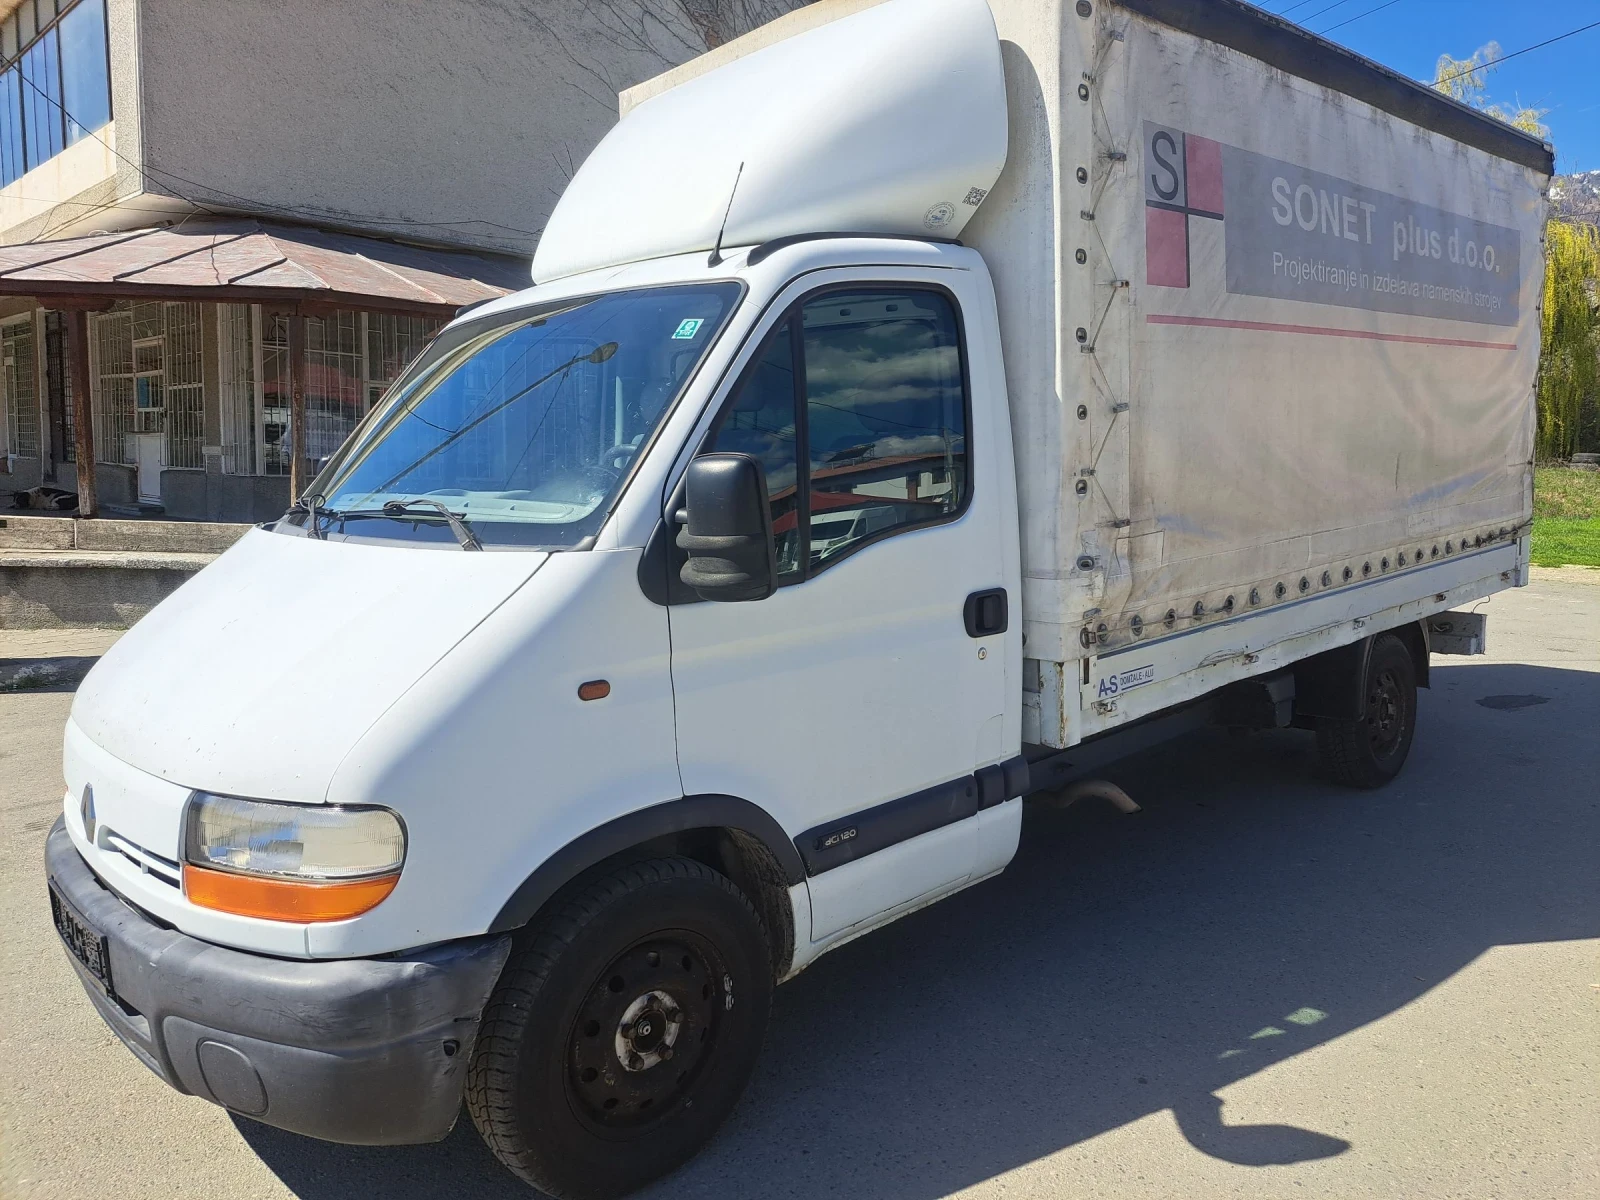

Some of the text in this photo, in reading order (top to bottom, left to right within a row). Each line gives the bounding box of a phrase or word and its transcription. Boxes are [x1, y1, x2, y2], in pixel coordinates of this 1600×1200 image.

[1151, 131, 1179, 201] S
[1271, 176, 1500, 273] SONET plus d.o.o.
[1272, 251, 1501, 313] Projektiranje in izdelava namenskih strojev
[1098, 674, 1118, 698] A-S
[840, 829, 856, 841] 120
